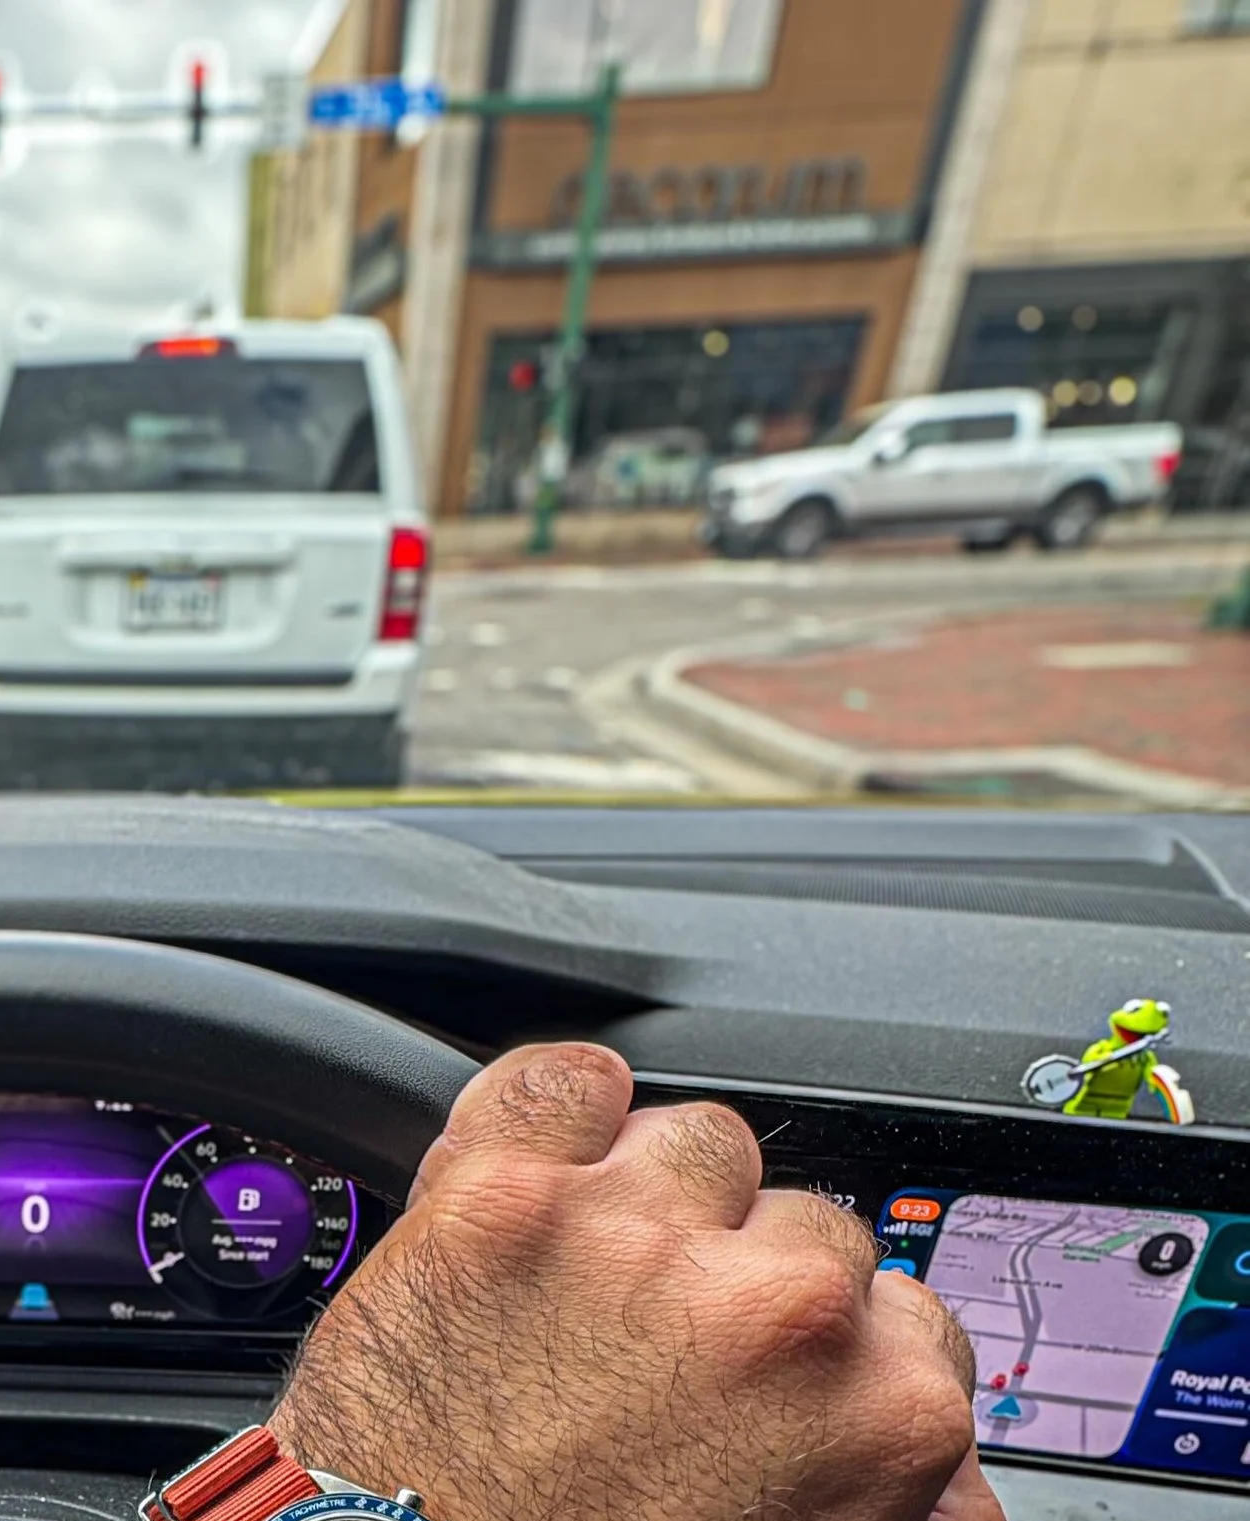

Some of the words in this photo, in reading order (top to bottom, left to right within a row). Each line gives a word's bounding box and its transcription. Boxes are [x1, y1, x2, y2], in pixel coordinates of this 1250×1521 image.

[195, 1142, 217, 1157] 60
[162, 1173, 183, 1188] 40
[316, 1177, 343, 1191] 120
[21, 1194, 50, 1233] 0
[899, 1203, 931, 1217] 9:23
[151, 1213, 170, 1228] 20
[323, 1218, 349, 1231] 140
[1159, 1239, 1177, 1262] 0
[310, 1256, 334, 1270] 180
[1171, 1369, 1229, 1392] Royal
[1176, 1390, 1203, 1405] The
